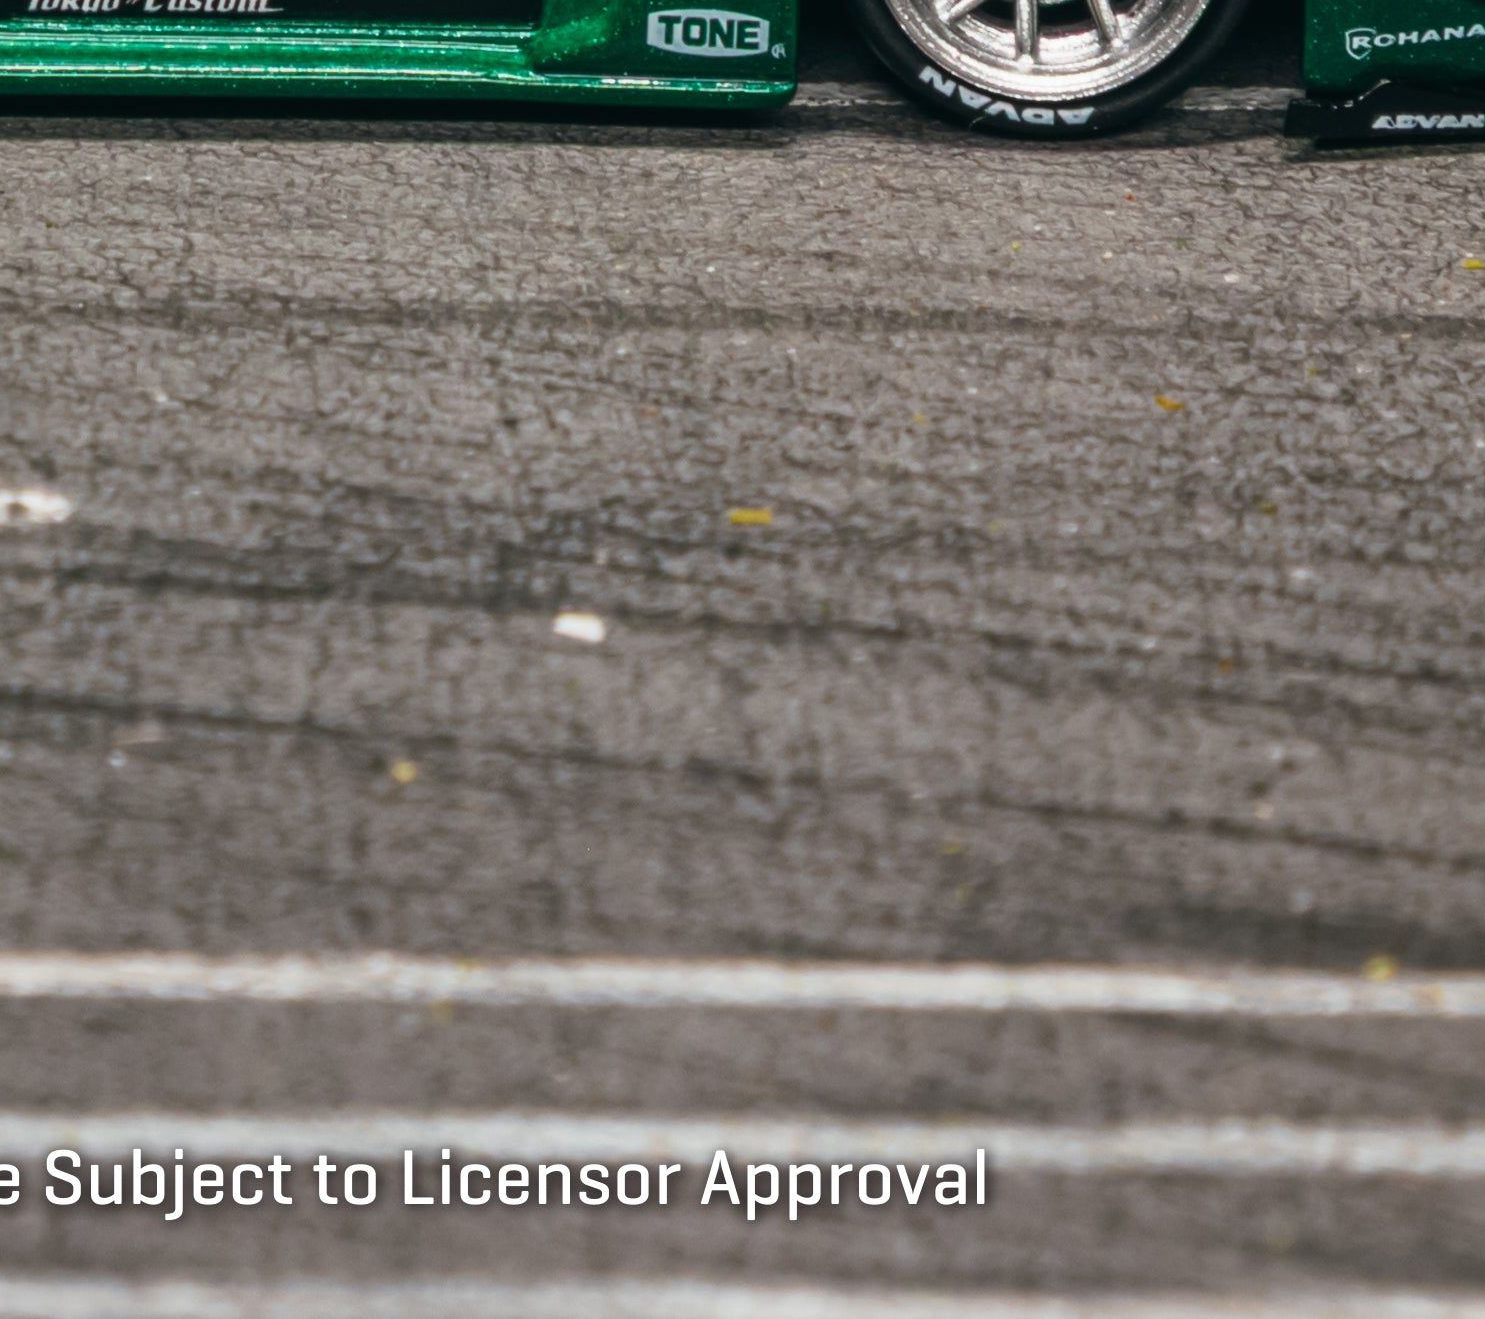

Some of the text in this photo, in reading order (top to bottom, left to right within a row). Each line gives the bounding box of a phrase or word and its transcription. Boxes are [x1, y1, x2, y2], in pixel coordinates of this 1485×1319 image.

[657, 15, 761, 51] TONE
[918, 65, 1095, 126] ADVAN
[1371, 113, 1485, 130] ADVAN
